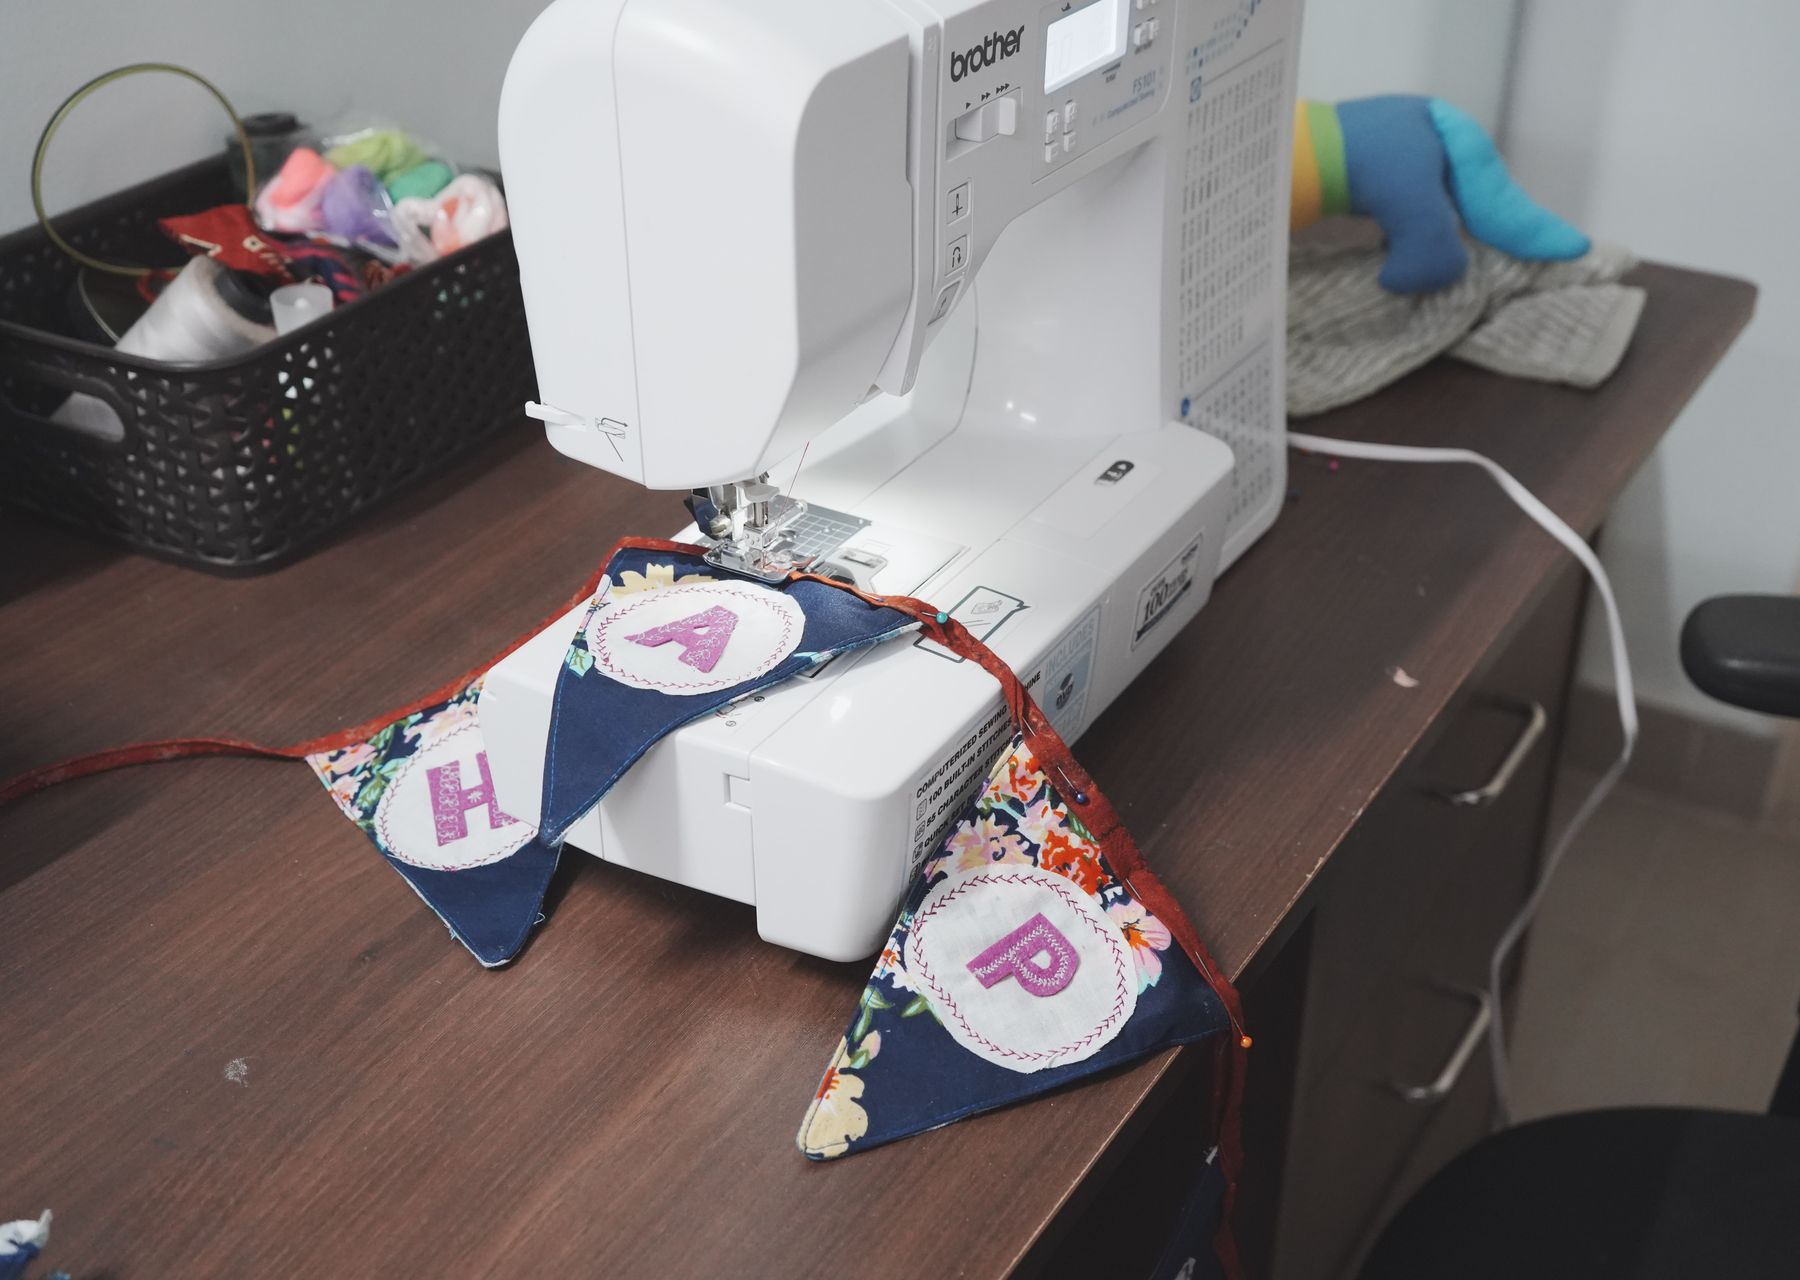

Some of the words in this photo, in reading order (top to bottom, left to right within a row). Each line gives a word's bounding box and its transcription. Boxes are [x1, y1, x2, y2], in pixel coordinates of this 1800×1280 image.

[950, 24, 1025, 83] brother
[622, 605, 740, 674] A
[916, 734, 978, 799] COMPUTERIZED
[978, 704, 1008, 739] SEWING
[1024, 671, 1041, 691] HINE
[425, 750, 520, 848] H
[926, 814, 937, 828] 55
[937, 763, 984, 816] CHARACTER
[984, 735, 1013, 769] STITCH
[928, 786, 943, 805] 100
[944, 752, 976, 790] BUILT-IN
[924, 820, 949, 848] QUICK
[966, 911, 1082, 998] P
